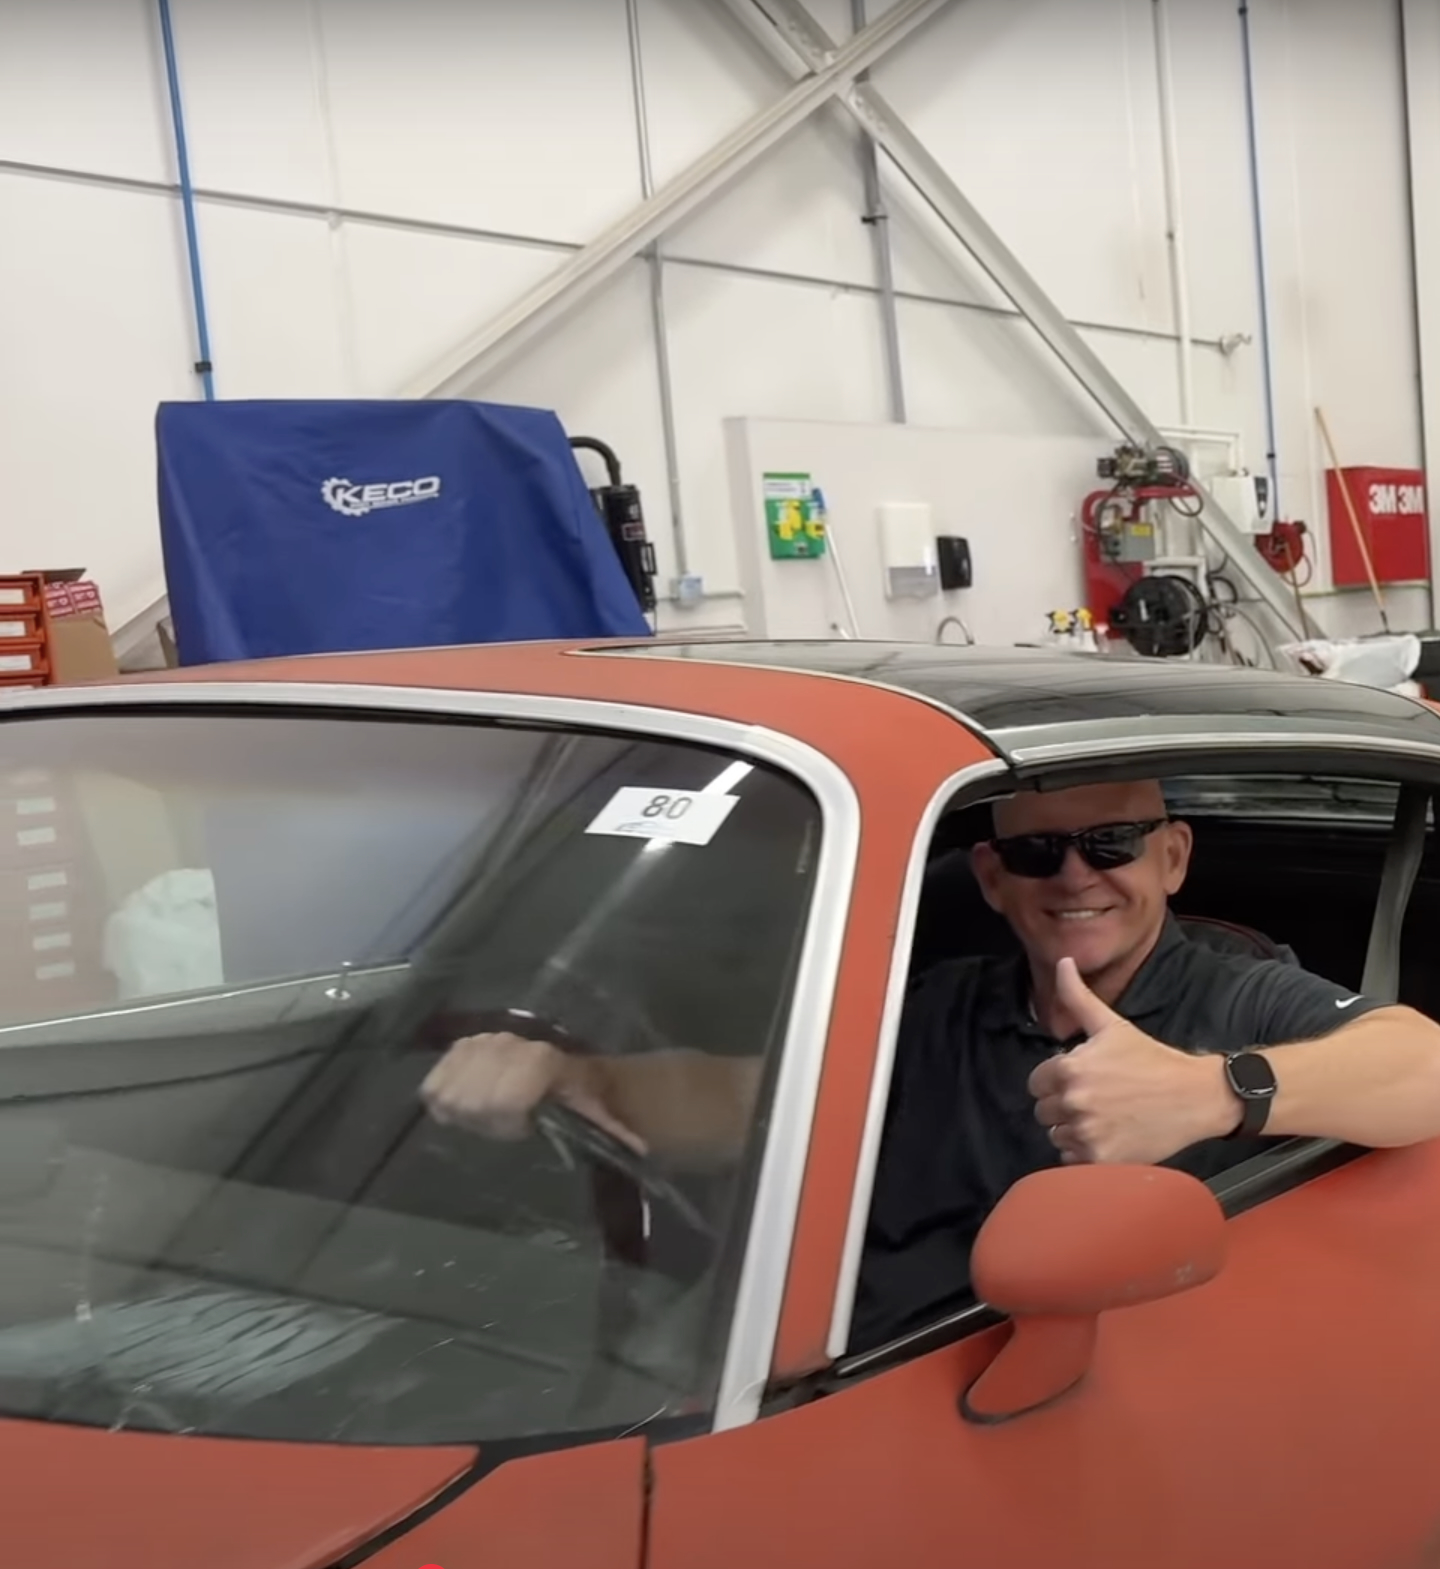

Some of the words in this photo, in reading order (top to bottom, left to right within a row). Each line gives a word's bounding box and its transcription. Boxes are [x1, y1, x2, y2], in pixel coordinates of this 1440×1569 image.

[335, 476, 441, 504] KECO
[1369, 484, 1397, 515] 3M
[1398, 485, 1424, 515] 3M
[641, 795, 693, 820] 80
